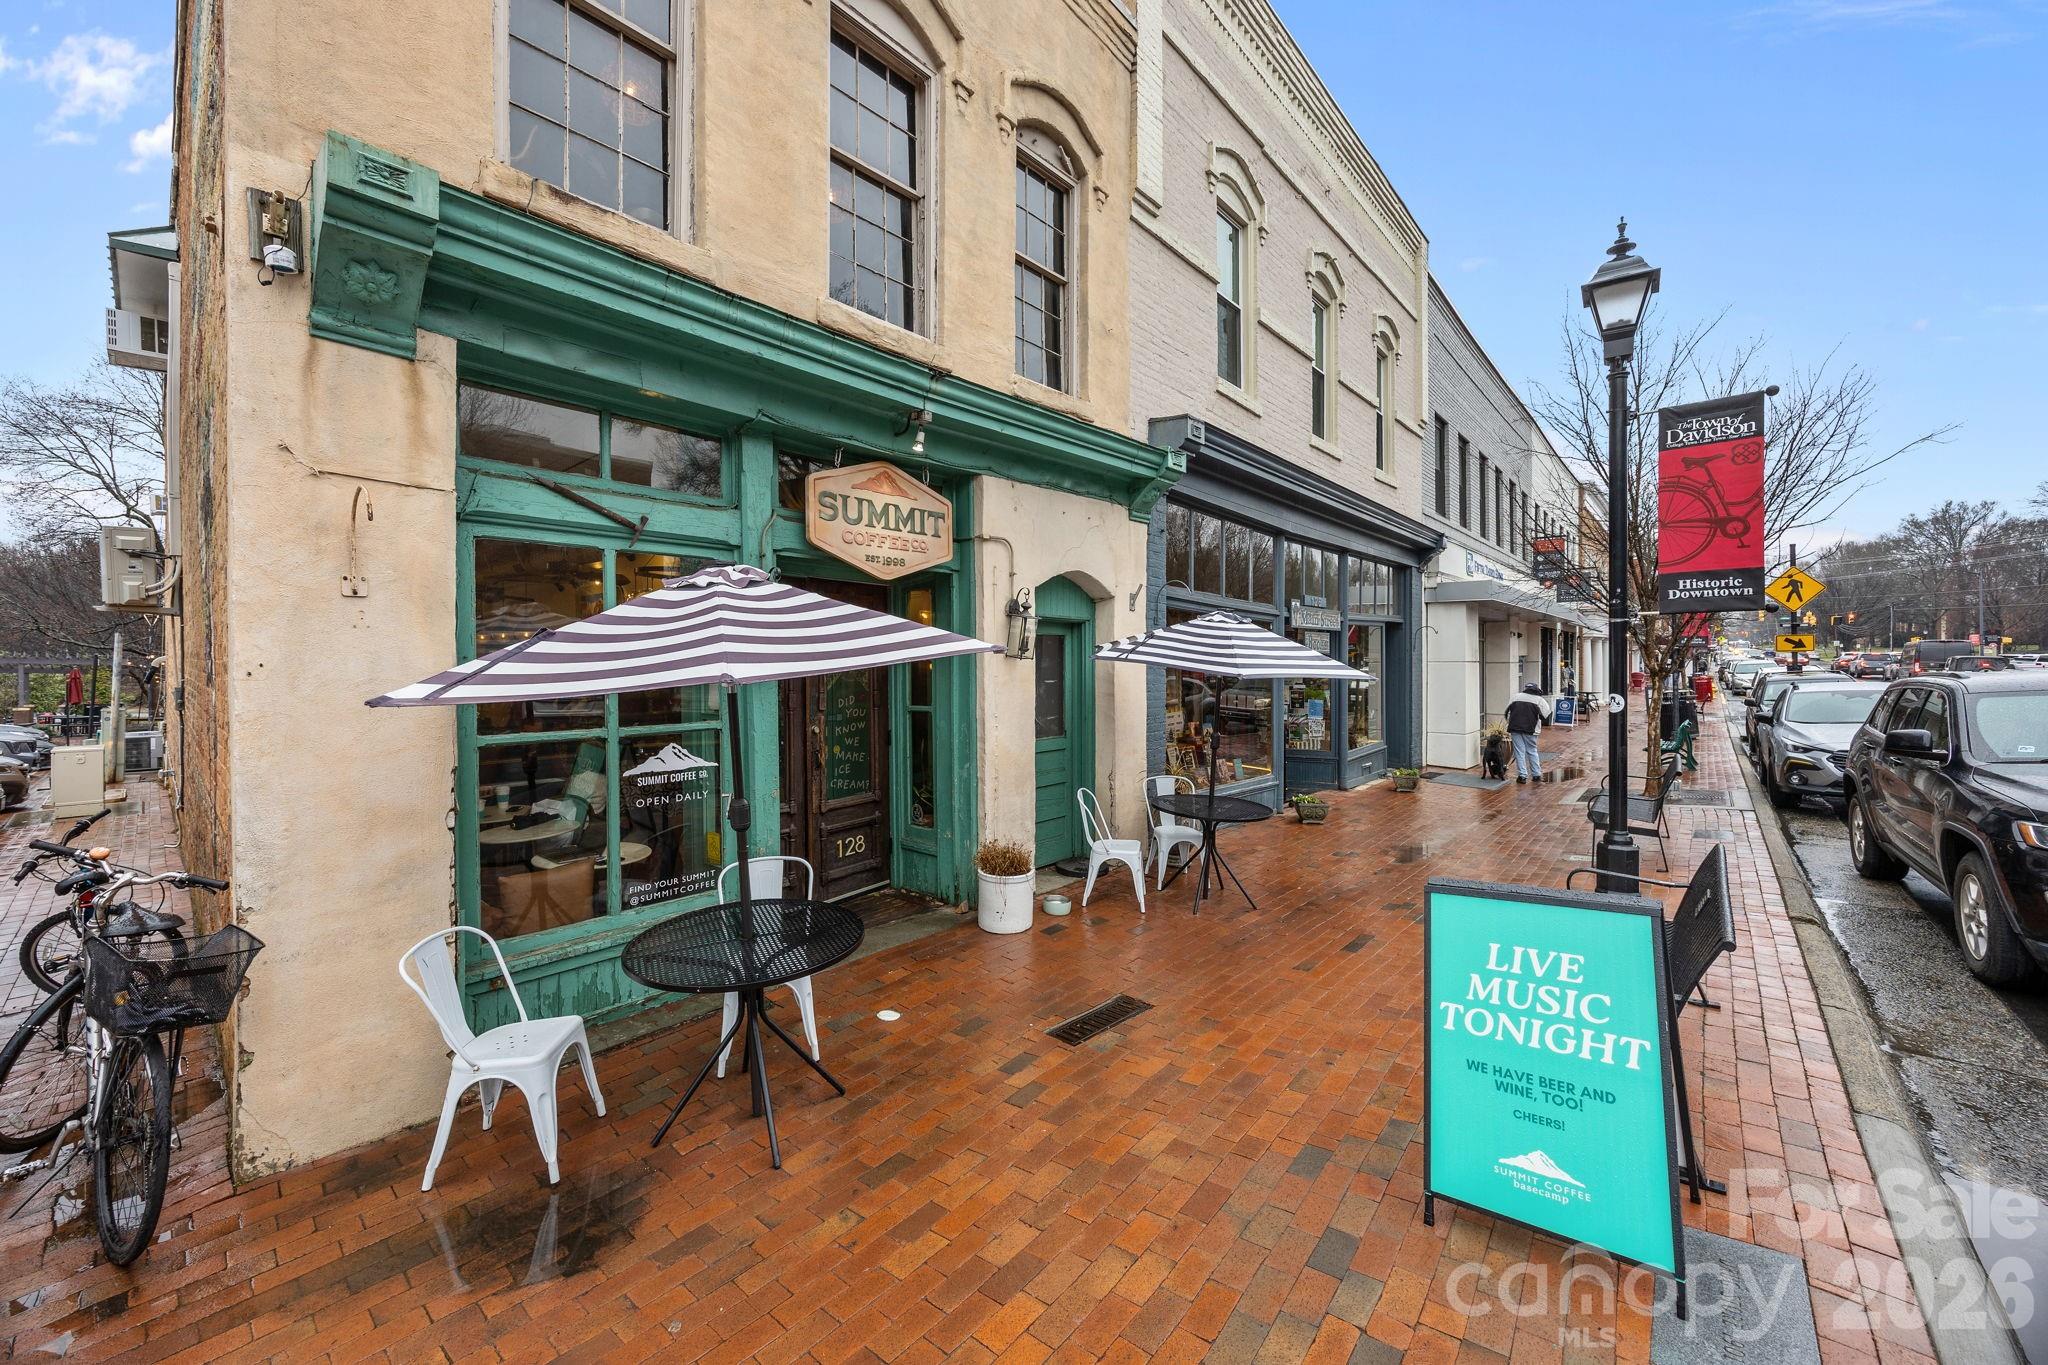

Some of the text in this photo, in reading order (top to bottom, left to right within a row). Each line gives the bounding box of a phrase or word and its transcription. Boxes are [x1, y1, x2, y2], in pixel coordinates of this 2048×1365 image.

[1688, 416, 1731, 430] Town
[1728, 412, 1746, 425] of
[1666, 421, 1757, 444] Davidson
[818, 490, 945, 538] SUMMIT
[842, 528, 929, 554] COFFEE CO.
[865, 553, 906, 567] EST. 1998
[1667, 586, 1754, 600] Downtown
[1678, 576, 1743, 590] Historic
[838, 695, 855, 708] DID
[846, 708, 866, 718] YOU
[835, 722, 866, 736] KNOW
[844, 737, 859, 746] WE
[835, 751, 866, 761] MAKE
[637, 769, 709, 787] SUMMIT COFFEE CO.
[834, 765, 851, 776] ICE
[830, 779, 870, 789] CREAM?
[635, 790, 709, 808] OPEN DAILY
[836, 835, 866, 858] 128
[629, 869, 716, 894] FIND YOUR SUMMIT
[629, 879, 716, 906] @SUMMITCOFFEE
[1486, 943, 1585, 984] LIVE
[1466, 974, 1611, 1025] MUSIC
[1440, 1002, 1651, 1070] TONIGHT
[1466, 1058, 1617, 1105] WE HAVE BEER AND
[1495, 1079, 1584, 1112] WINE, TOO!
[1513, 1109, 1565, 1131] CHEERS!
[1494, 1165, 1592, 1202] SUMMIT COFFEE
[1513, 1179, 1569, 1205] basecamp
[1721, 1332, 1746, 1364] 1901
